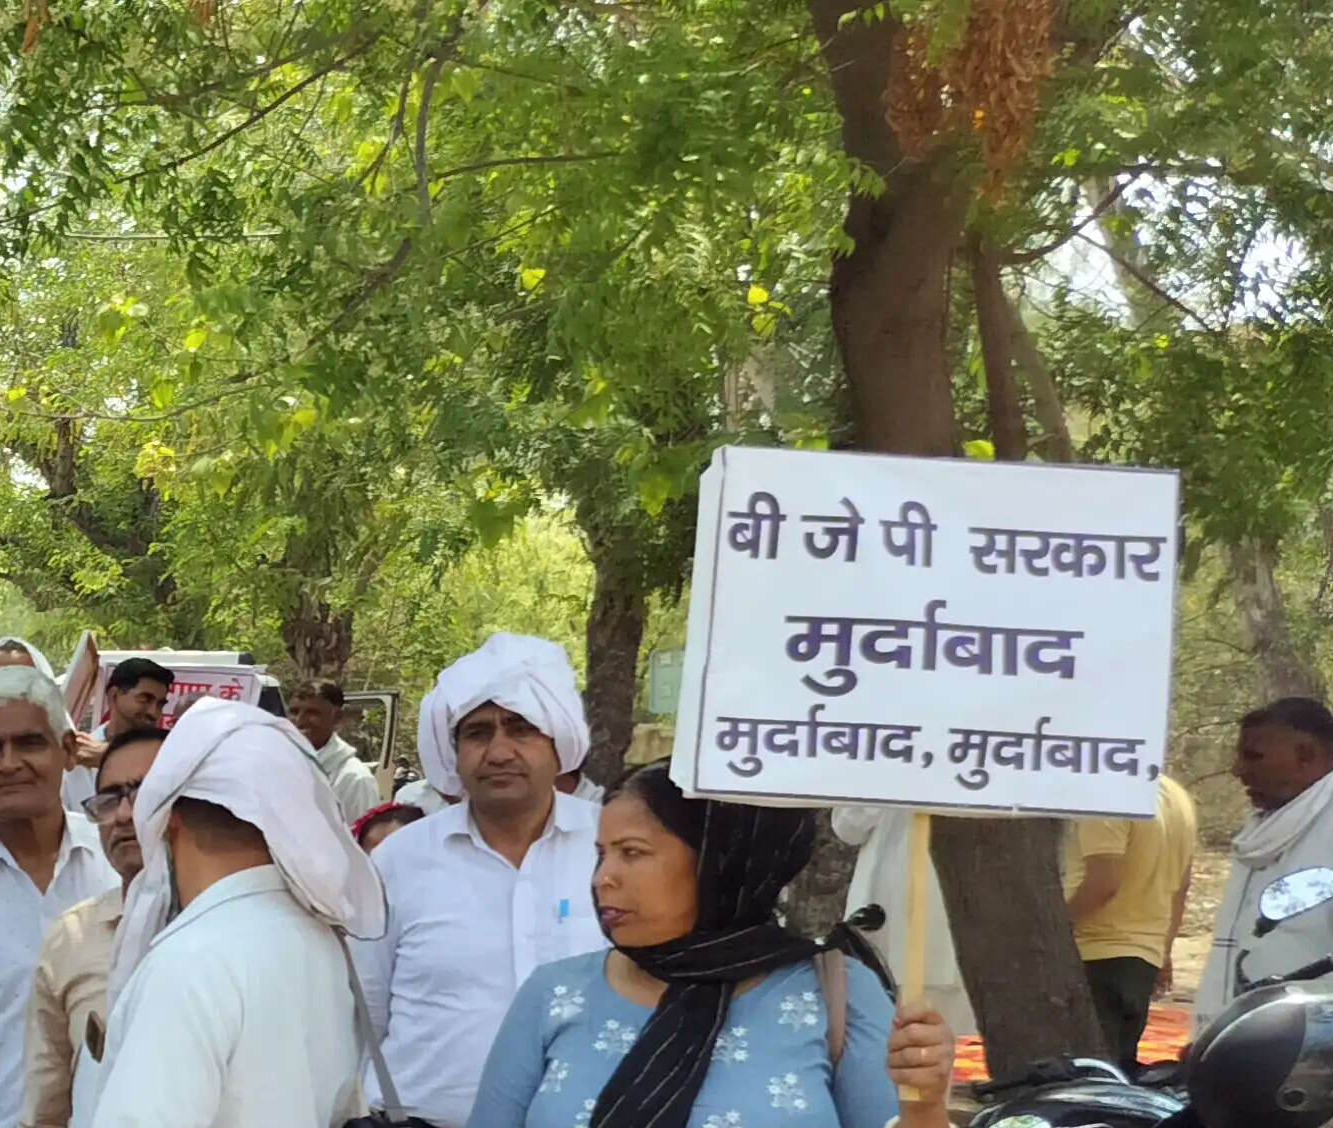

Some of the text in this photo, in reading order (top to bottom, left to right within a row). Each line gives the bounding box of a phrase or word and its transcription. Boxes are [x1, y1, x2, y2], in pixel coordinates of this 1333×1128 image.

[728, 492, 1167, 582] बी जे पी सरकार
[785, 600, 1084, 697] मुर्दाबाद
[716, 704, 1160, 790] मुर्दाबाद, मुर्दाबाद,
